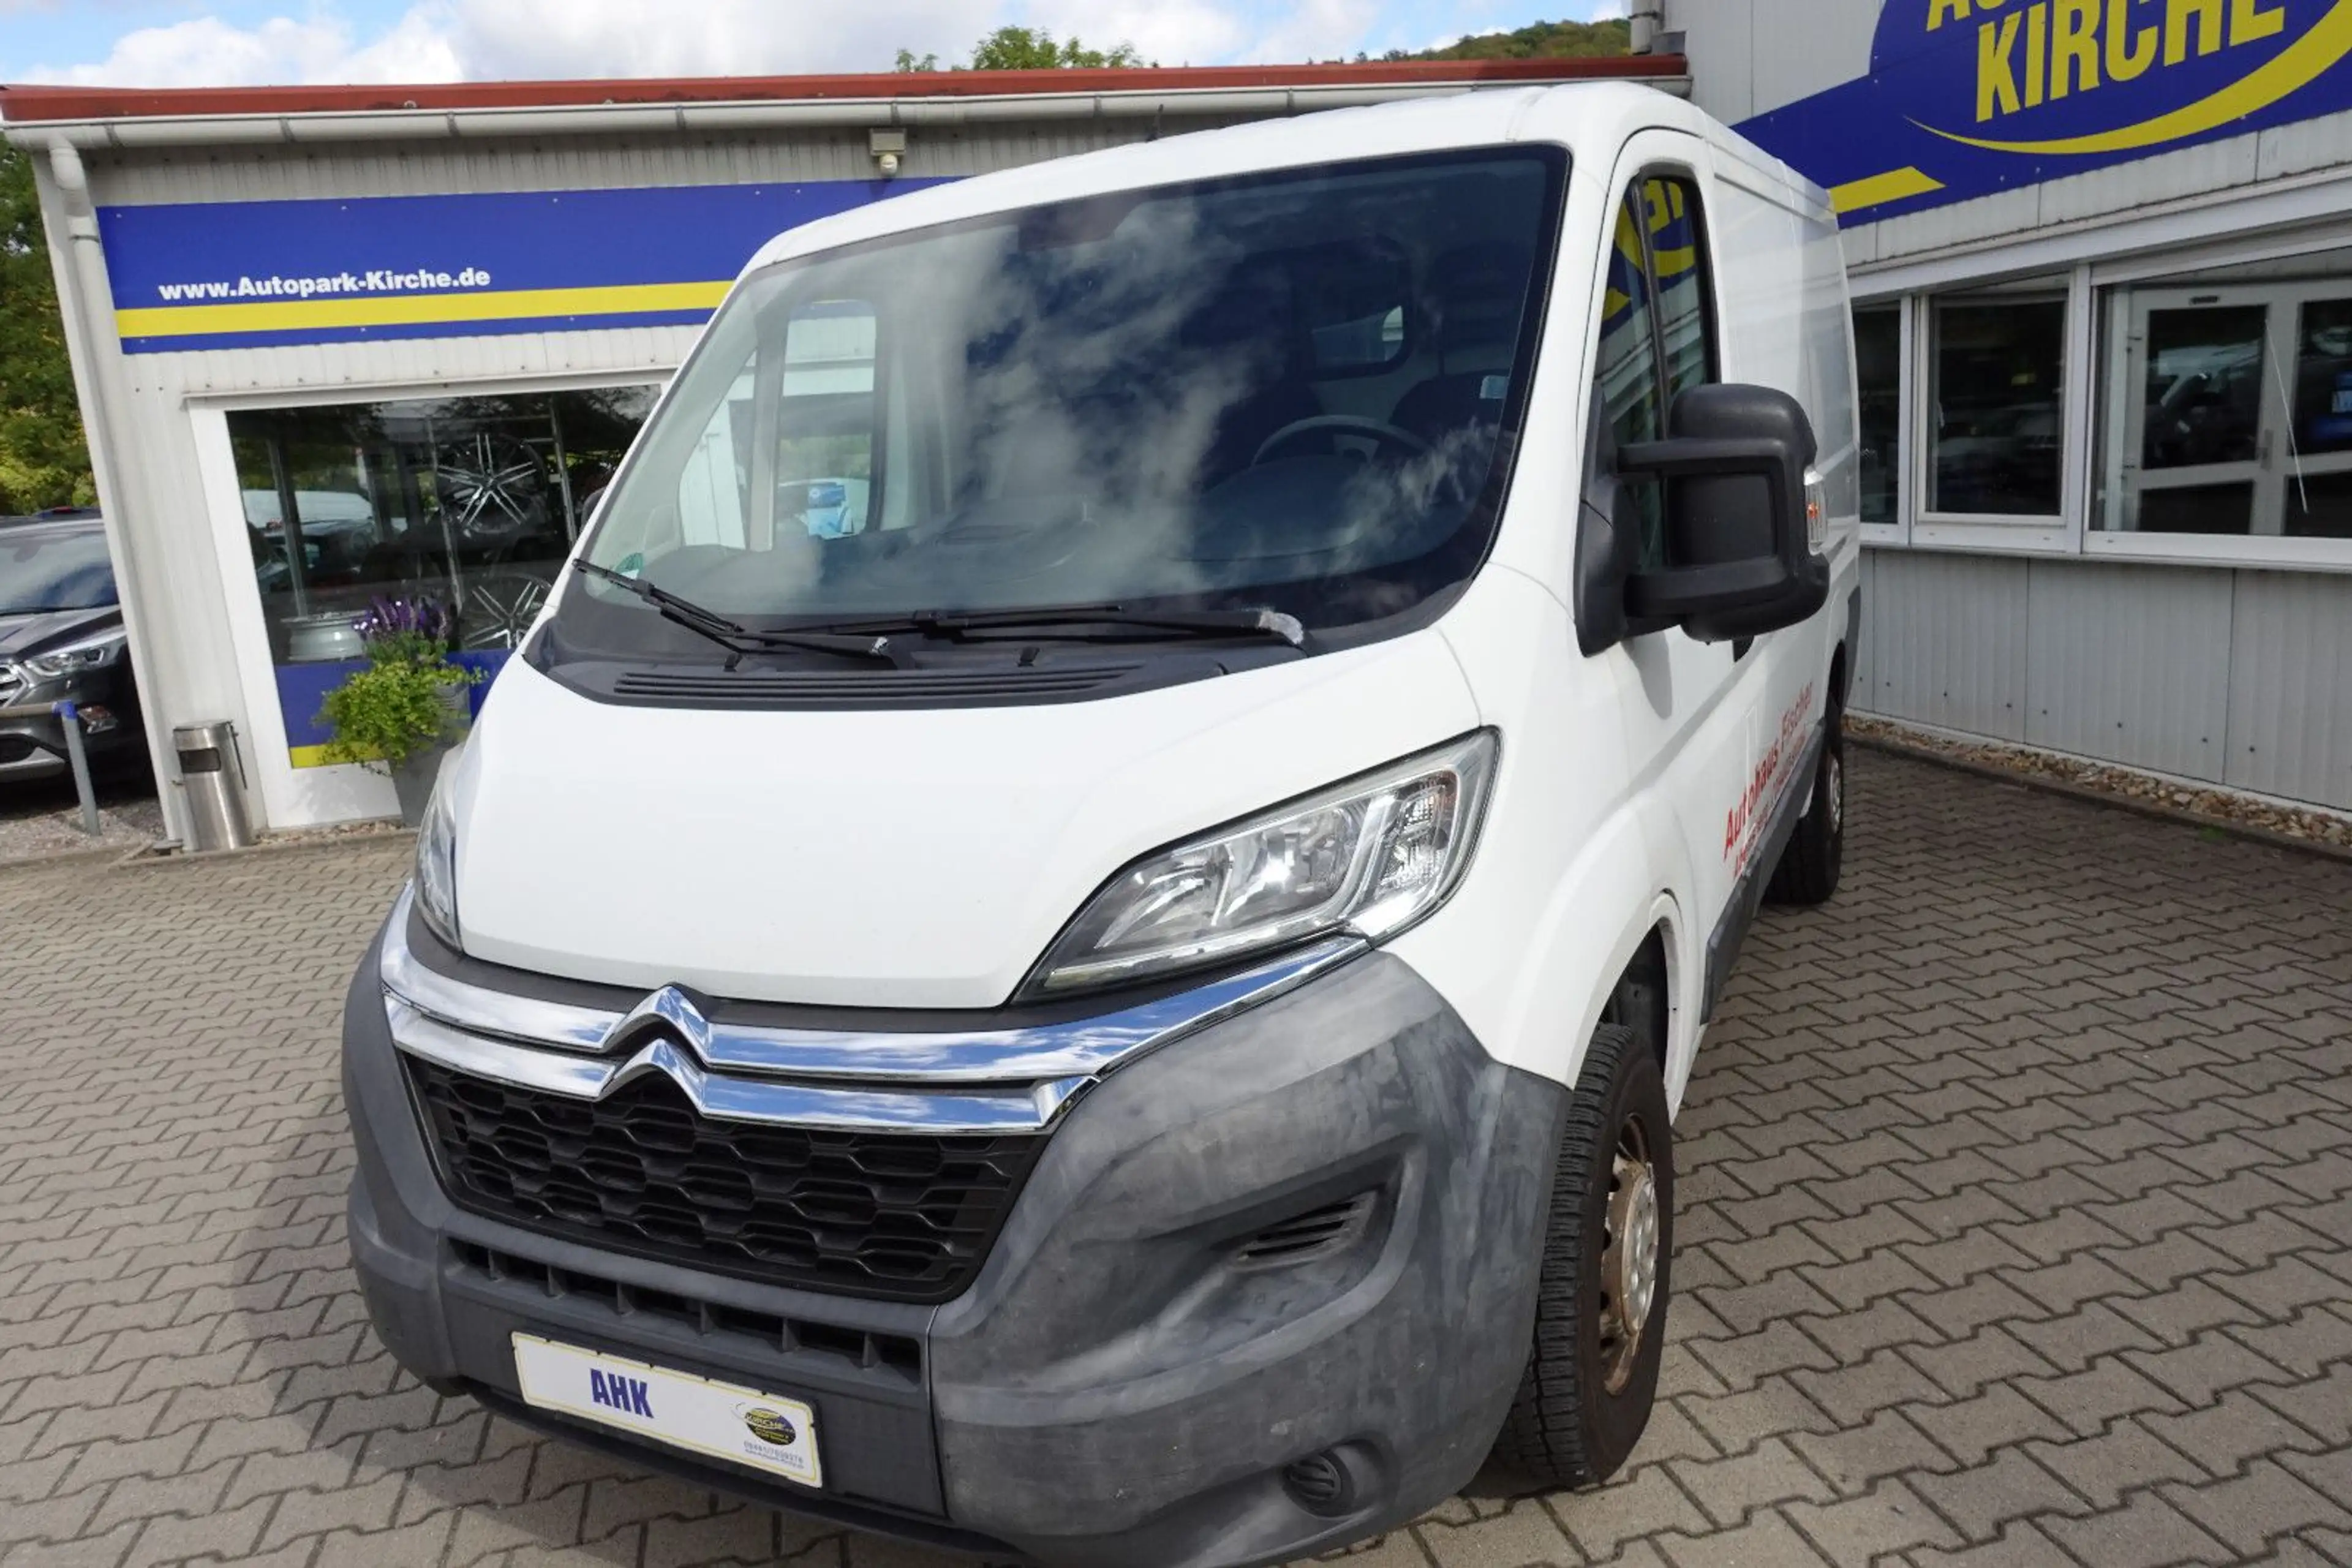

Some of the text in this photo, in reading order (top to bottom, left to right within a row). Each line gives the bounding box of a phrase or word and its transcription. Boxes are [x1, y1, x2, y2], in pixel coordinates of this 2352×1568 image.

[159, 268, 491, 300] www.Autopark-Kirche.de
[1724, 742, 1779, 863] Autohaus
[590, 1368, 654, 1419] AHK
